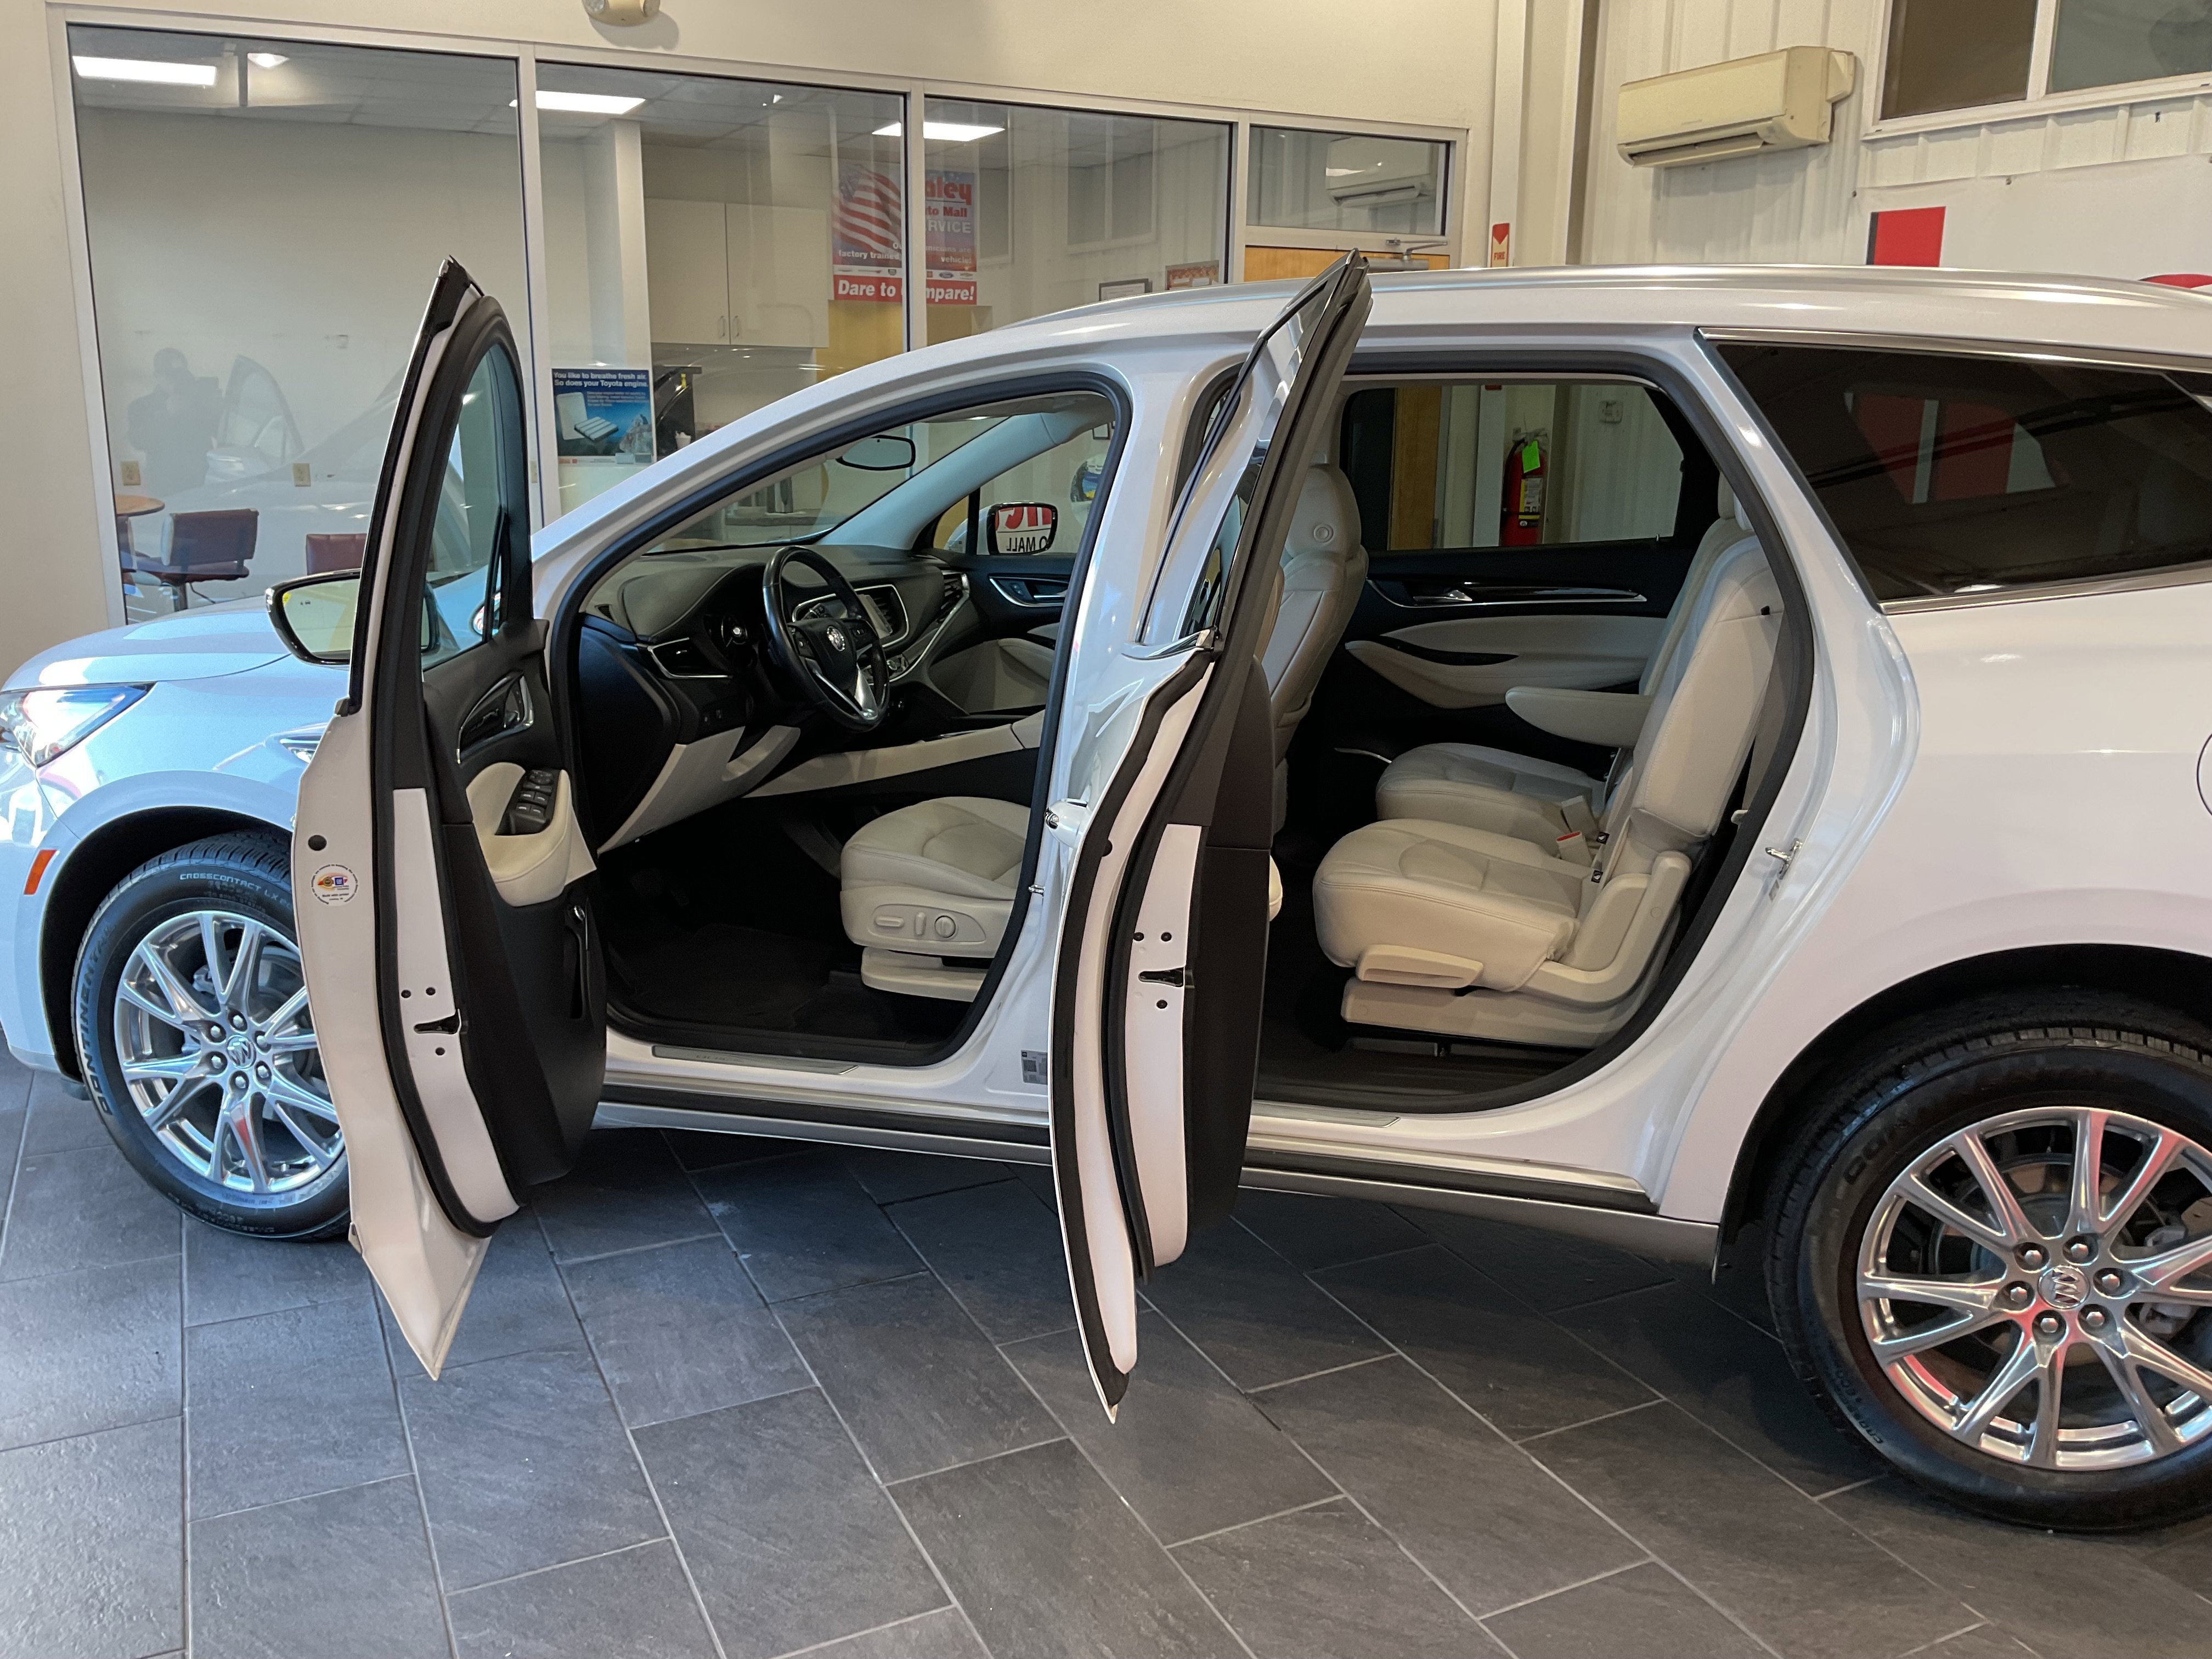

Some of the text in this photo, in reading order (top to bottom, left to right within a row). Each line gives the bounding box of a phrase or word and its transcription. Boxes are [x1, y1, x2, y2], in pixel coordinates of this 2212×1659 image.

[944, 206, 967, 217] Mall
[927, 219, 971, 233] RVICE
[838, 250, 868, 259] factory
[1493, 251, 1505, 261] FIRE
[838, 280, 974, 302] Dare to mpare!
[601, 380, 623, 388] Toyota
[180, 873, 262, 891] CROSSCONTACT
